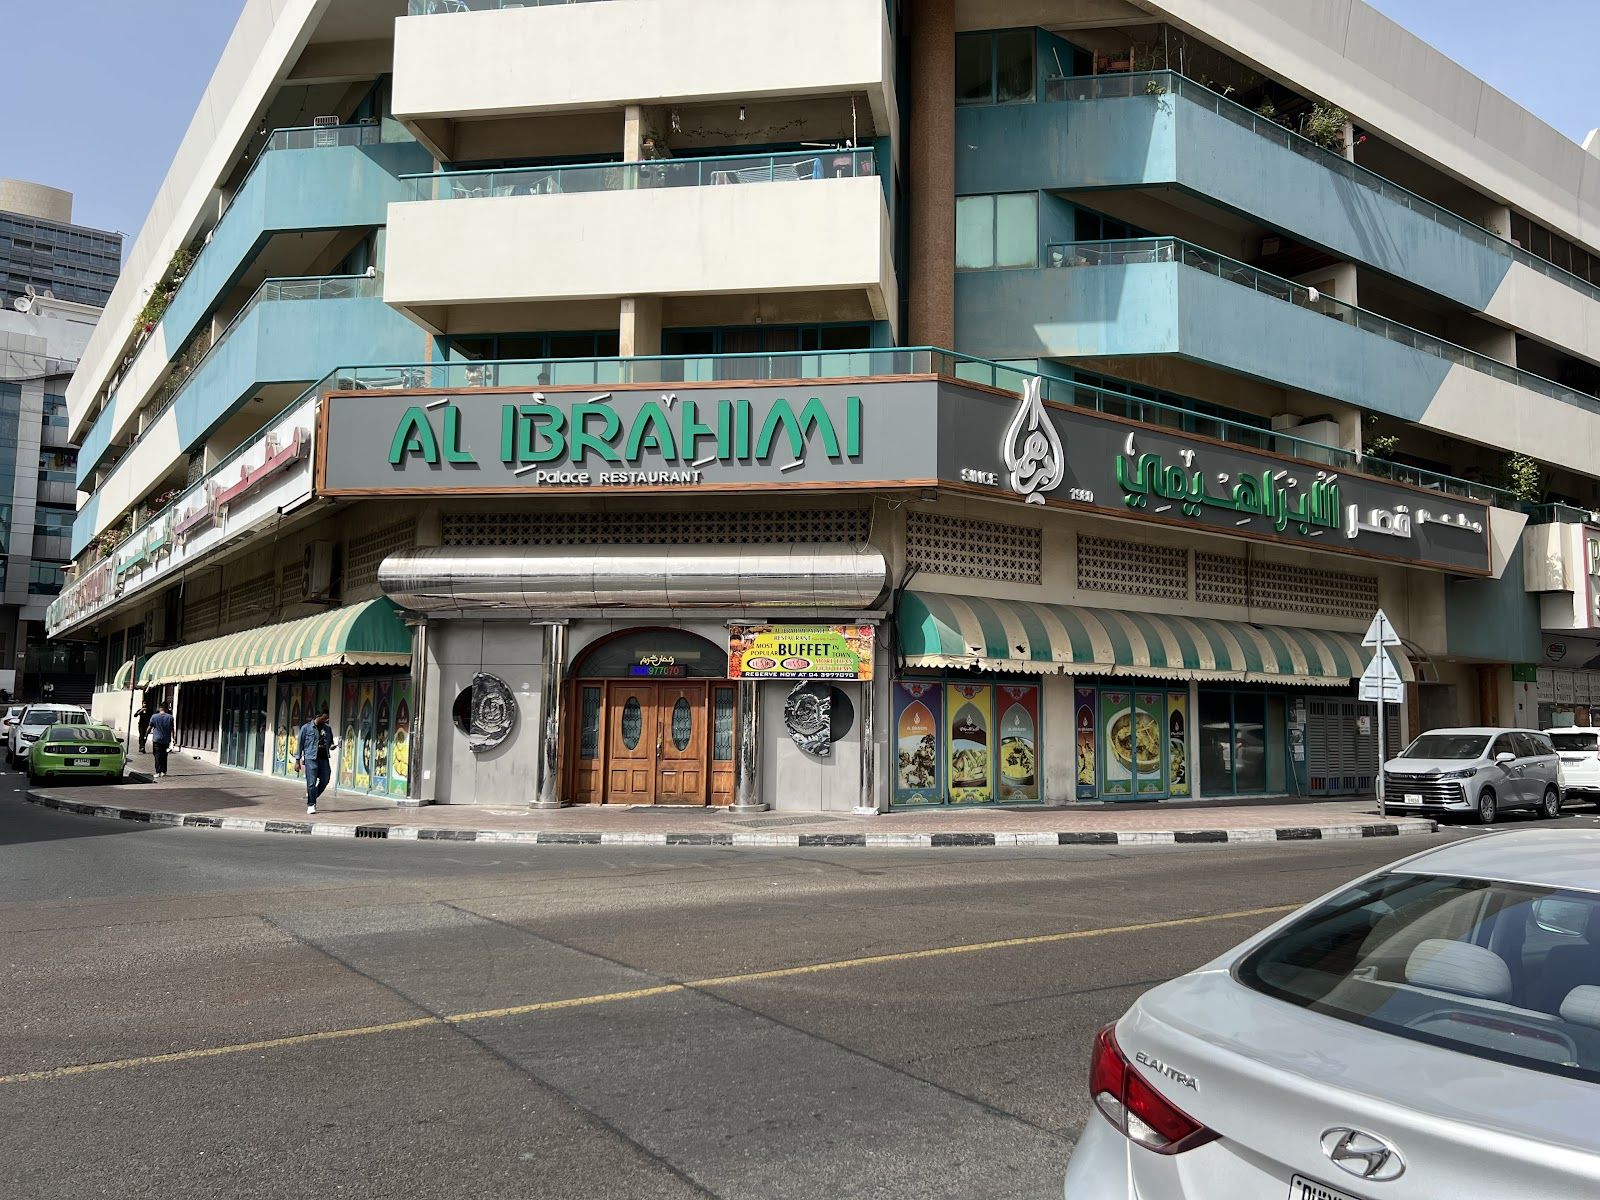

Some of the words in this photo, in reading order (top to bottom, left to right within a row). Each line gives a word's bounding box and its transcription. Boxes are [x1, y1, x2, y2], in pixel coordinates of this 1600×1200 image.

[388, 404, 474, 464] AL
[500, 396, 861, 463] IBRAHIMI
[536, 470, 589, 485] Palace
[600, 470, 701, 483] RESTAURANT
[961, 468, 998, 486] SINCE
[1069, 487, 1094, 503] 1980
[1346, 503, 1412, 539] قصر
[1415, 509, 1483, 534] مطعم
[778, 643, 831, 656] BUFFET
[1136, 1051, 1198, 1091] ELANTRA
